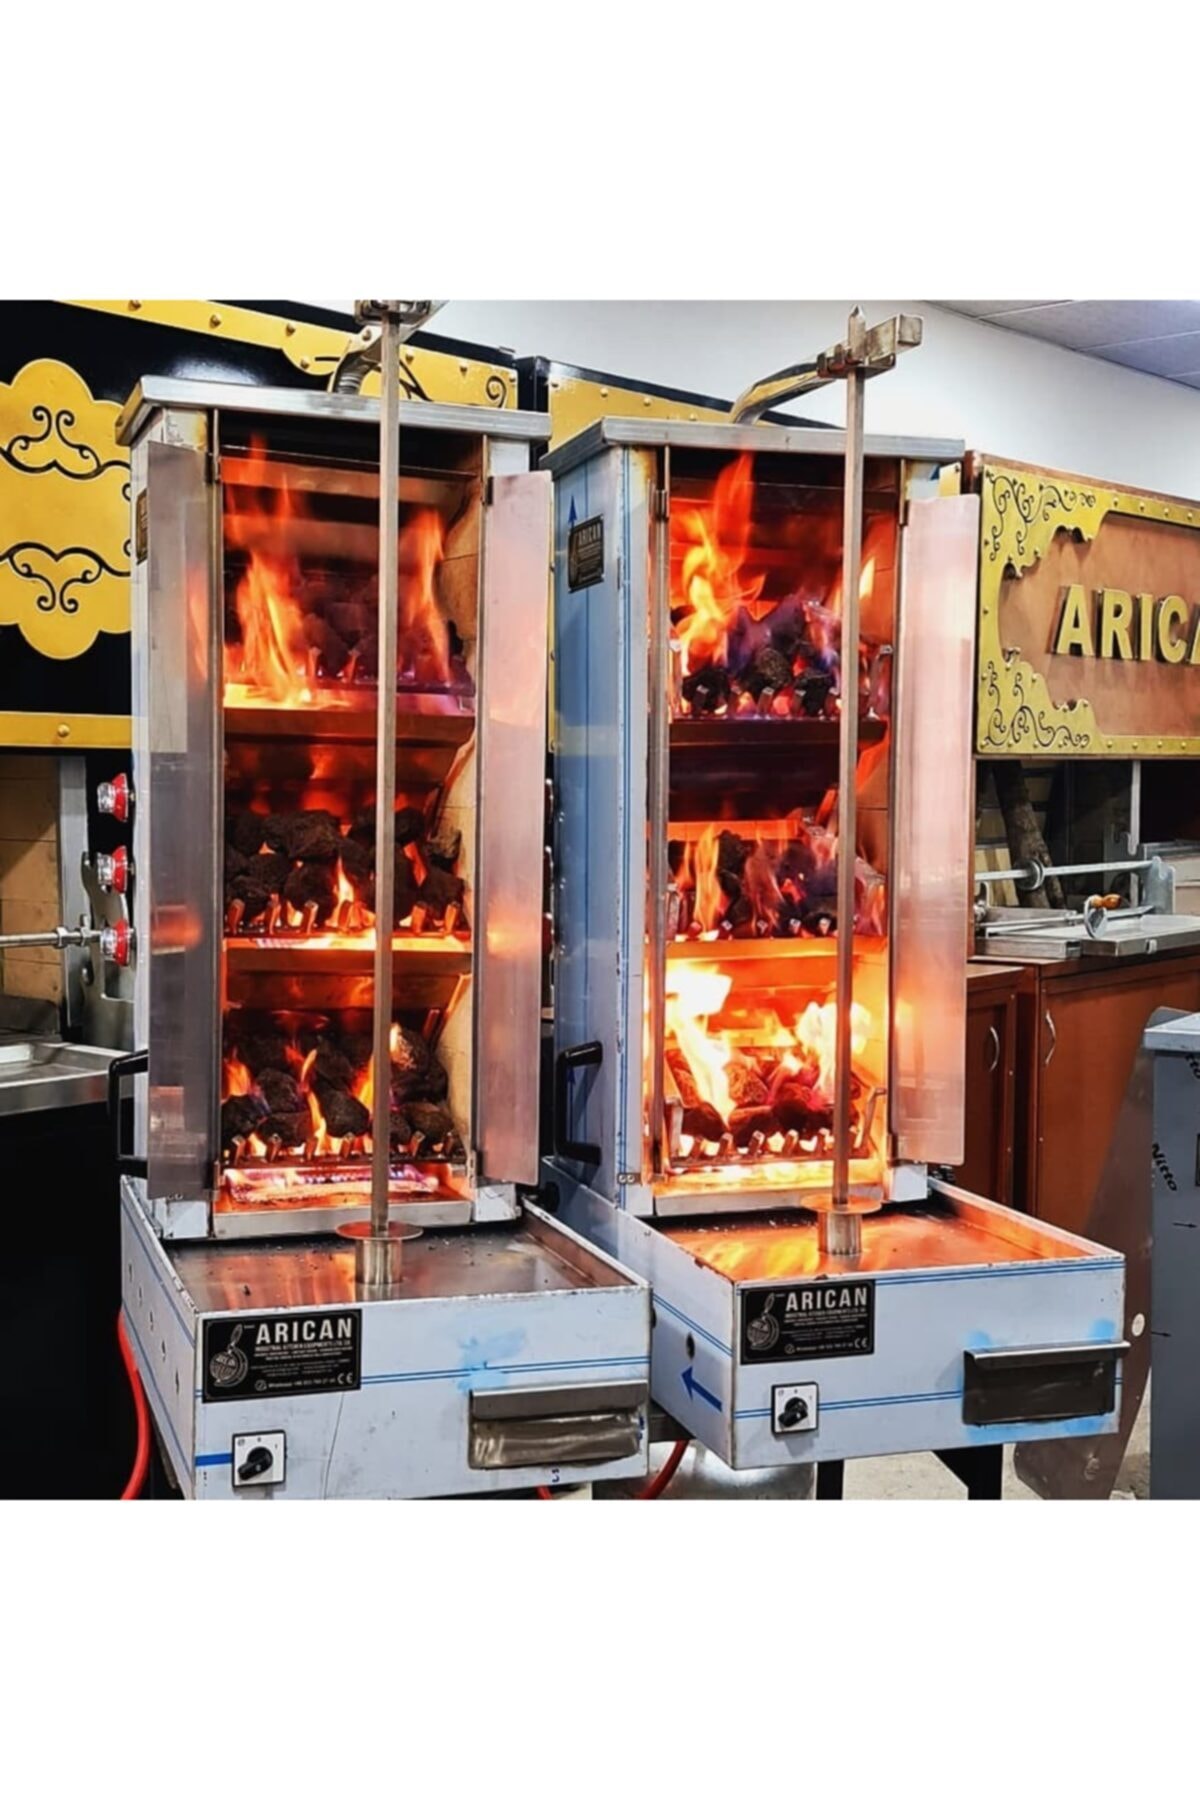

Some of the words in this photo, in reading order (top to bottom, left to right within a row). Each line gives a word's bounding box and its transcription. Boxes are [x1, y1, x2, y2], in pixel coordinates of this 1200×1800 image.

[1054, 583, 1200, 665] ARIC
[1151, 1143, 1178, 1192] Nitto
[784, 1286, 867, 1312] ARICAN
[255, 1317, 352, 1345] ARICAN
